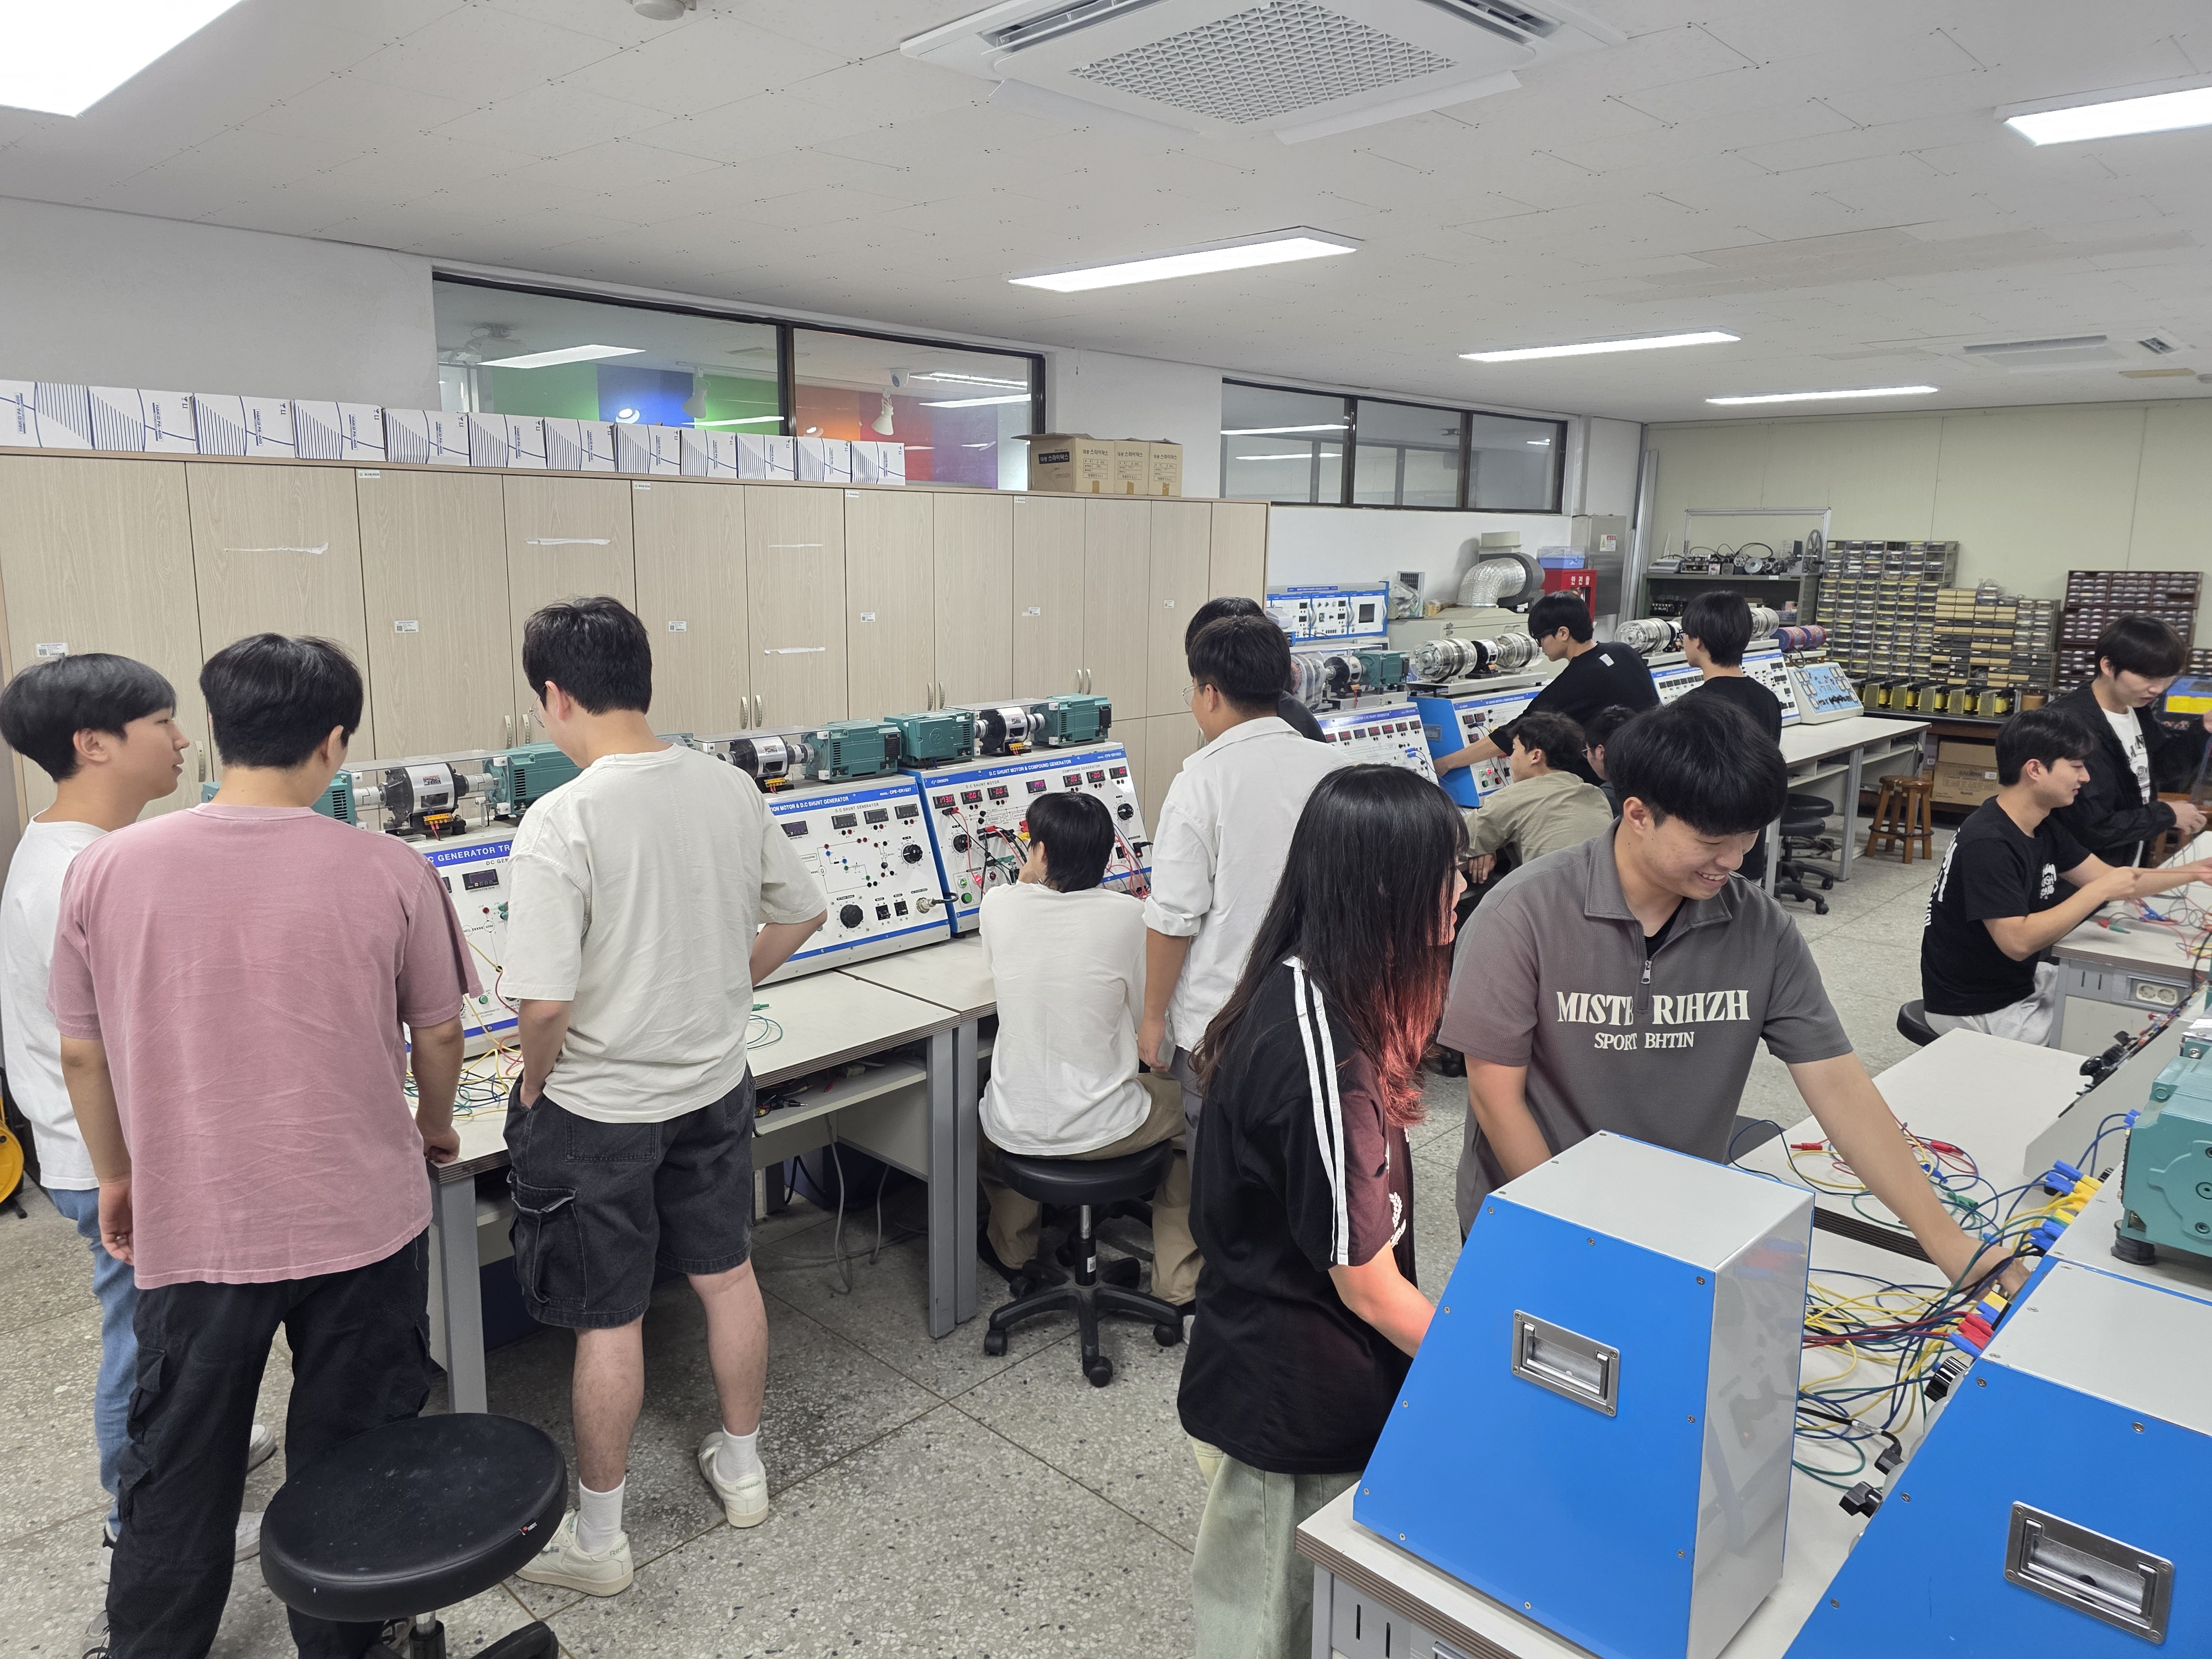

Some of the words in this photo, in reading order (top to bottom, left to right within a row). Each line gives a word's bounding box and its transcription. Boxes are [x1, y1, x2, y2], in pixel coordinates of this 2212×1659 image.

[780, 802, 796, 811] MOTOR
[823, 796, 849, 804] GENERATOR
[438, 847, 495, 862] GENERATOR
[472, 1008, 500, 1017] ELCTROMAGNETIC
[1652, 990, 1750, 1025] RIHZH
[1594, 1032, 1637, 1050] SPORT
[1644, 1031, 1694, 1049] BHTIN
